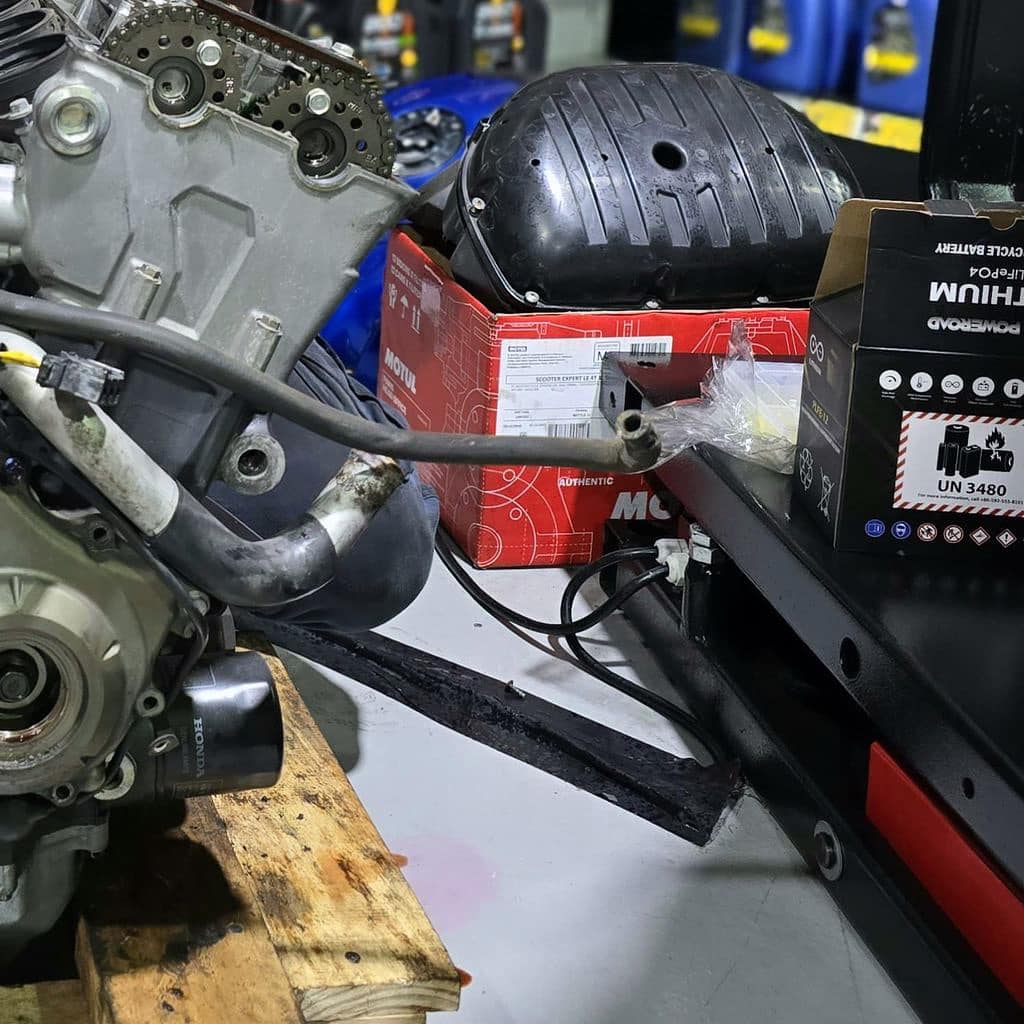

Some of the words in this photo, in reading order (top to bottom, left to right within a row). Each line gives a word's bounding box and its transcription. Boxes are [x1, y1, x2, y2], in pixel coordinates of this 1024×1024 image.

[935, 242, 984, 257] BATTERY
[986, 245, 1024, 258] CYCLE
[969, 266, 1024, 280] LiFePO4
[927, 316, 1021, 336] POWEROAD
[384, 347, 416, 395] MOTUL
[559, 477, 614, 487] AUTHENTIC
[938, 480, 962, 493] UN
[966, 483, 1007, 497] 3480
[193, 717, 205, 778] HONDA
